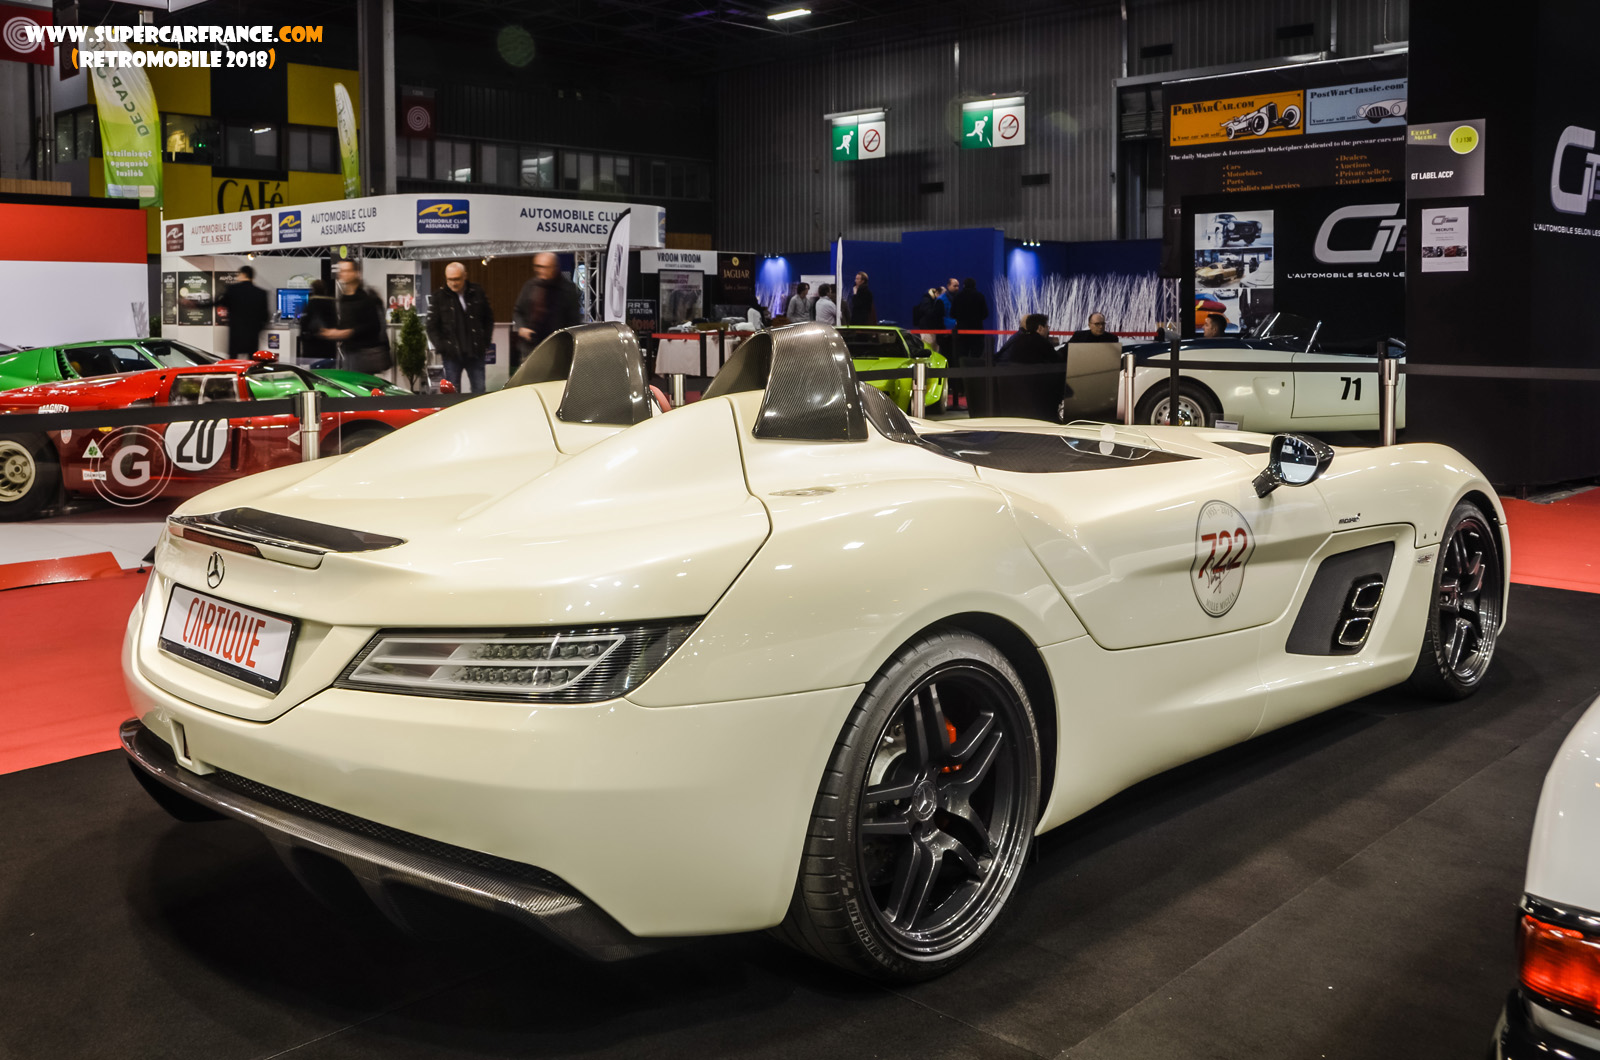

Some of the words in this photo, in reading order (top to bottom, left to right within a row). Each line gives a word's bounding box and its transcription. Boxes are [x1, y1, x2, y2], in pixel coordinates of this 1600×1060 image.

[1419, 171, 1437, 179] LABEL
[311, 209, 356, 224] AUTOMOBILE
[358, 206, 377, 218] CLUB
[520, 208, 594, 221] AUTOMOBILE
[191, 223, 227, 235] AUTOMOBILE
[227, 221, 243, 232] CLUB
[320, 222, 366, 236] ASSURANCES
[536, 222, 609, 235] ASSURANCES
[201, 234, 232, 244] CLASSIC
[657, 253, 679, 262] VROOM
[680, 254, 702, 263] VROOM
[723, 269, 751, 279] JAGUAR
[1340, 376, 1362, 401] 71
[176, 419, 215, 465] 20
[111, 444, 151, 487] G
[1197, 527, 1248, 579] 722
[182, 597, 267, 669] CARTIQUE
[847, 900, 884, 957] MICHELIN
